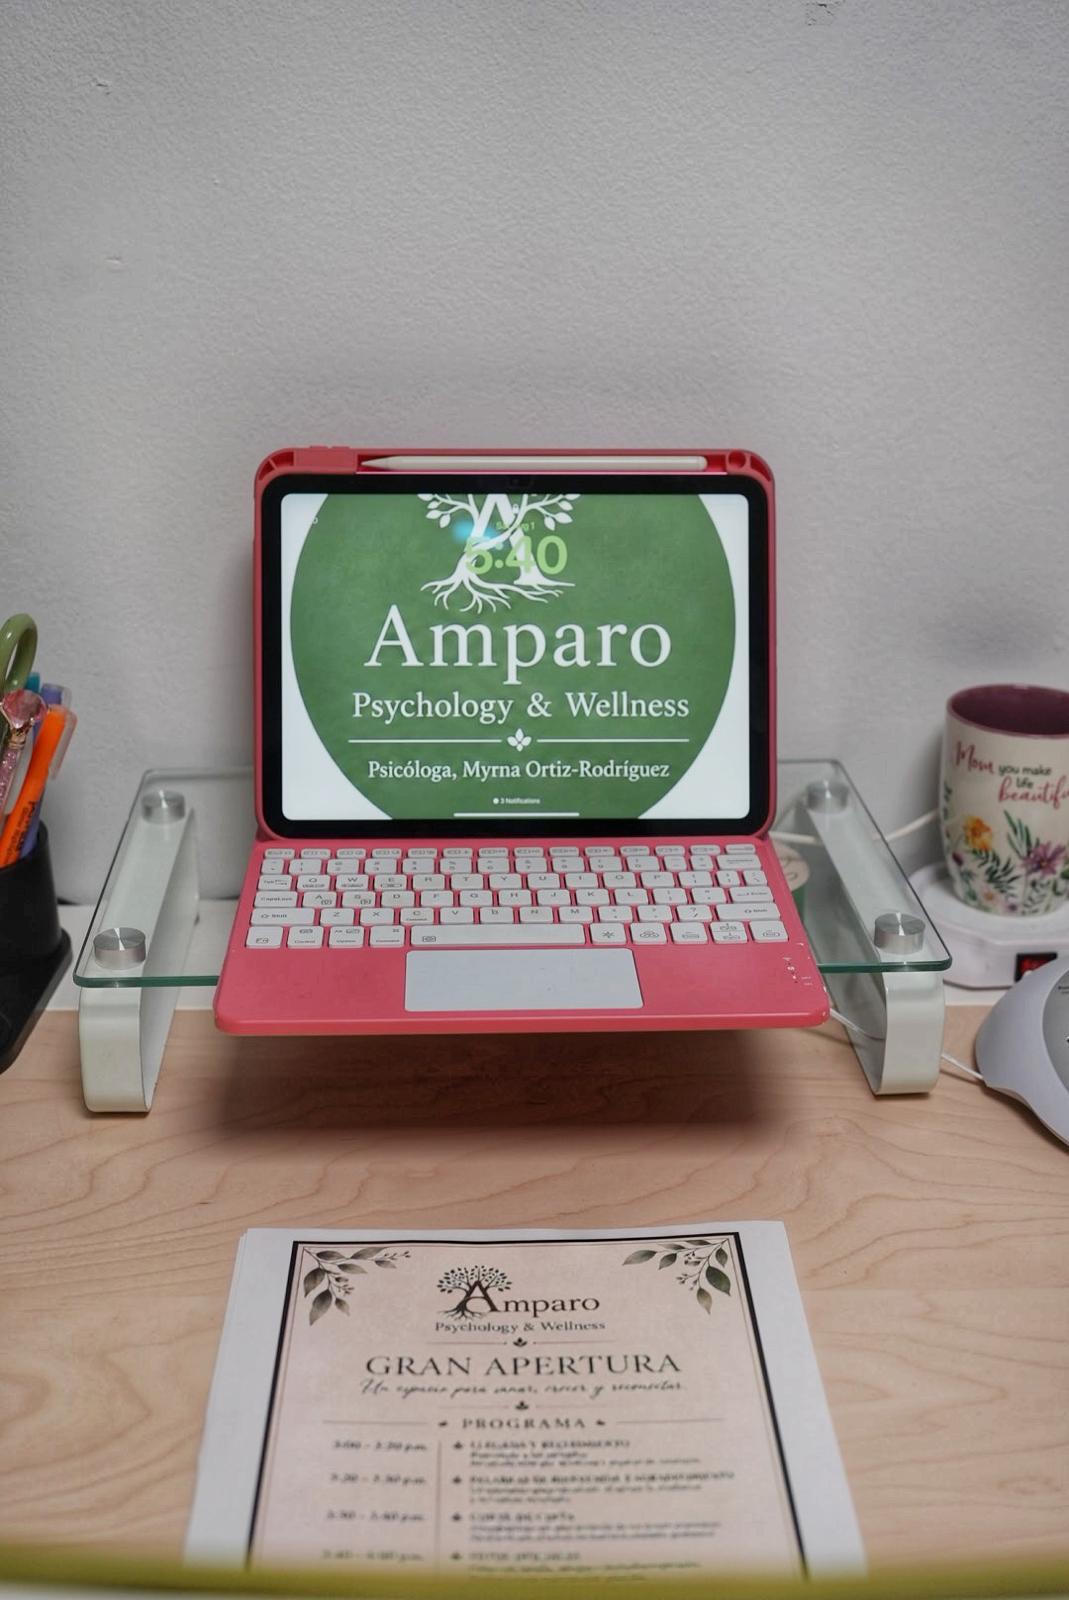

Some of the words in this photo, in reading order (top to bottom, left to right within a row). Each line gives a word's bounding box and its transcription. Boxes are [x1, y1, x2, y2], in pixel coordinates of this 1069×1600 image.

[364, 603, 671, 685] Amparo
[352, 691, 514, 724] Psychology
[526, 692, 553, 718] &
[564, 690, 690, 718] Wellness
[368, 759, 458, 782] Psicóloga,
[462, 760, 521, 783] Myrna
[525, 759, 670, 782] Ortiz-Rodríguez
[956, 741, 994, 775] Mom
[998, 765, 1020, 777] you
[1022, 764, 1052, 776] make
[1016, 777, 1034, 789] life
[456, 1279, 600, 1319] Amparo
[435, 1321, 519, 1334] Psychology
[523, 1322, 535, 1332] &
[540, 1320, 606, 1332] Wellness
[366, 1356, 471, 1376] GRAN
[485, 1354, 682, 1376] APERTURA
[462, 1417, 586, 1430] PROGRAMA
